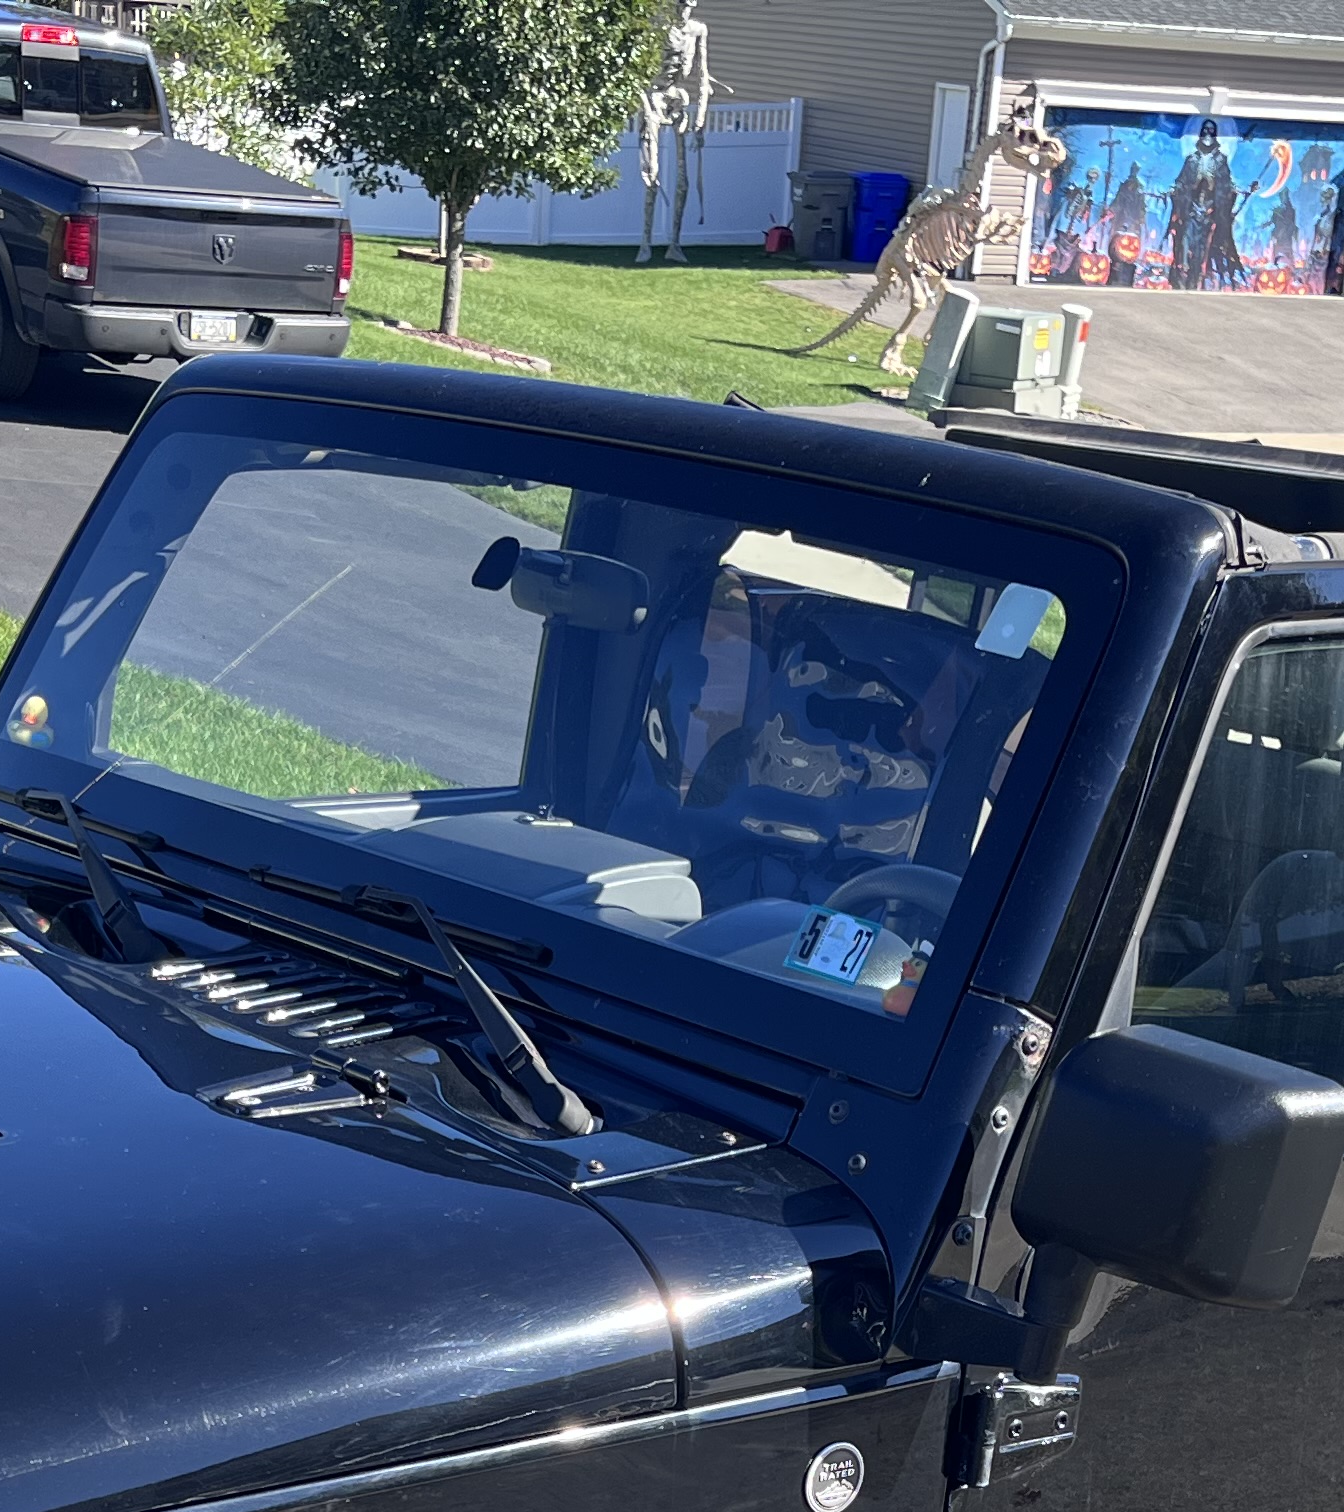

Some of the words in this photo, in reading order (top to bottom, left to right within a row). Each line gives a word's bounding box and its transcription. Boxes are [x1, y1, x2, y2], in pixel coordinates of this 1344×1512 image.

[839, 929, 873, 975] 27
[822, 1459, 854, 1473] TRAIL
[819, 1468, 856, 1482] RATED
